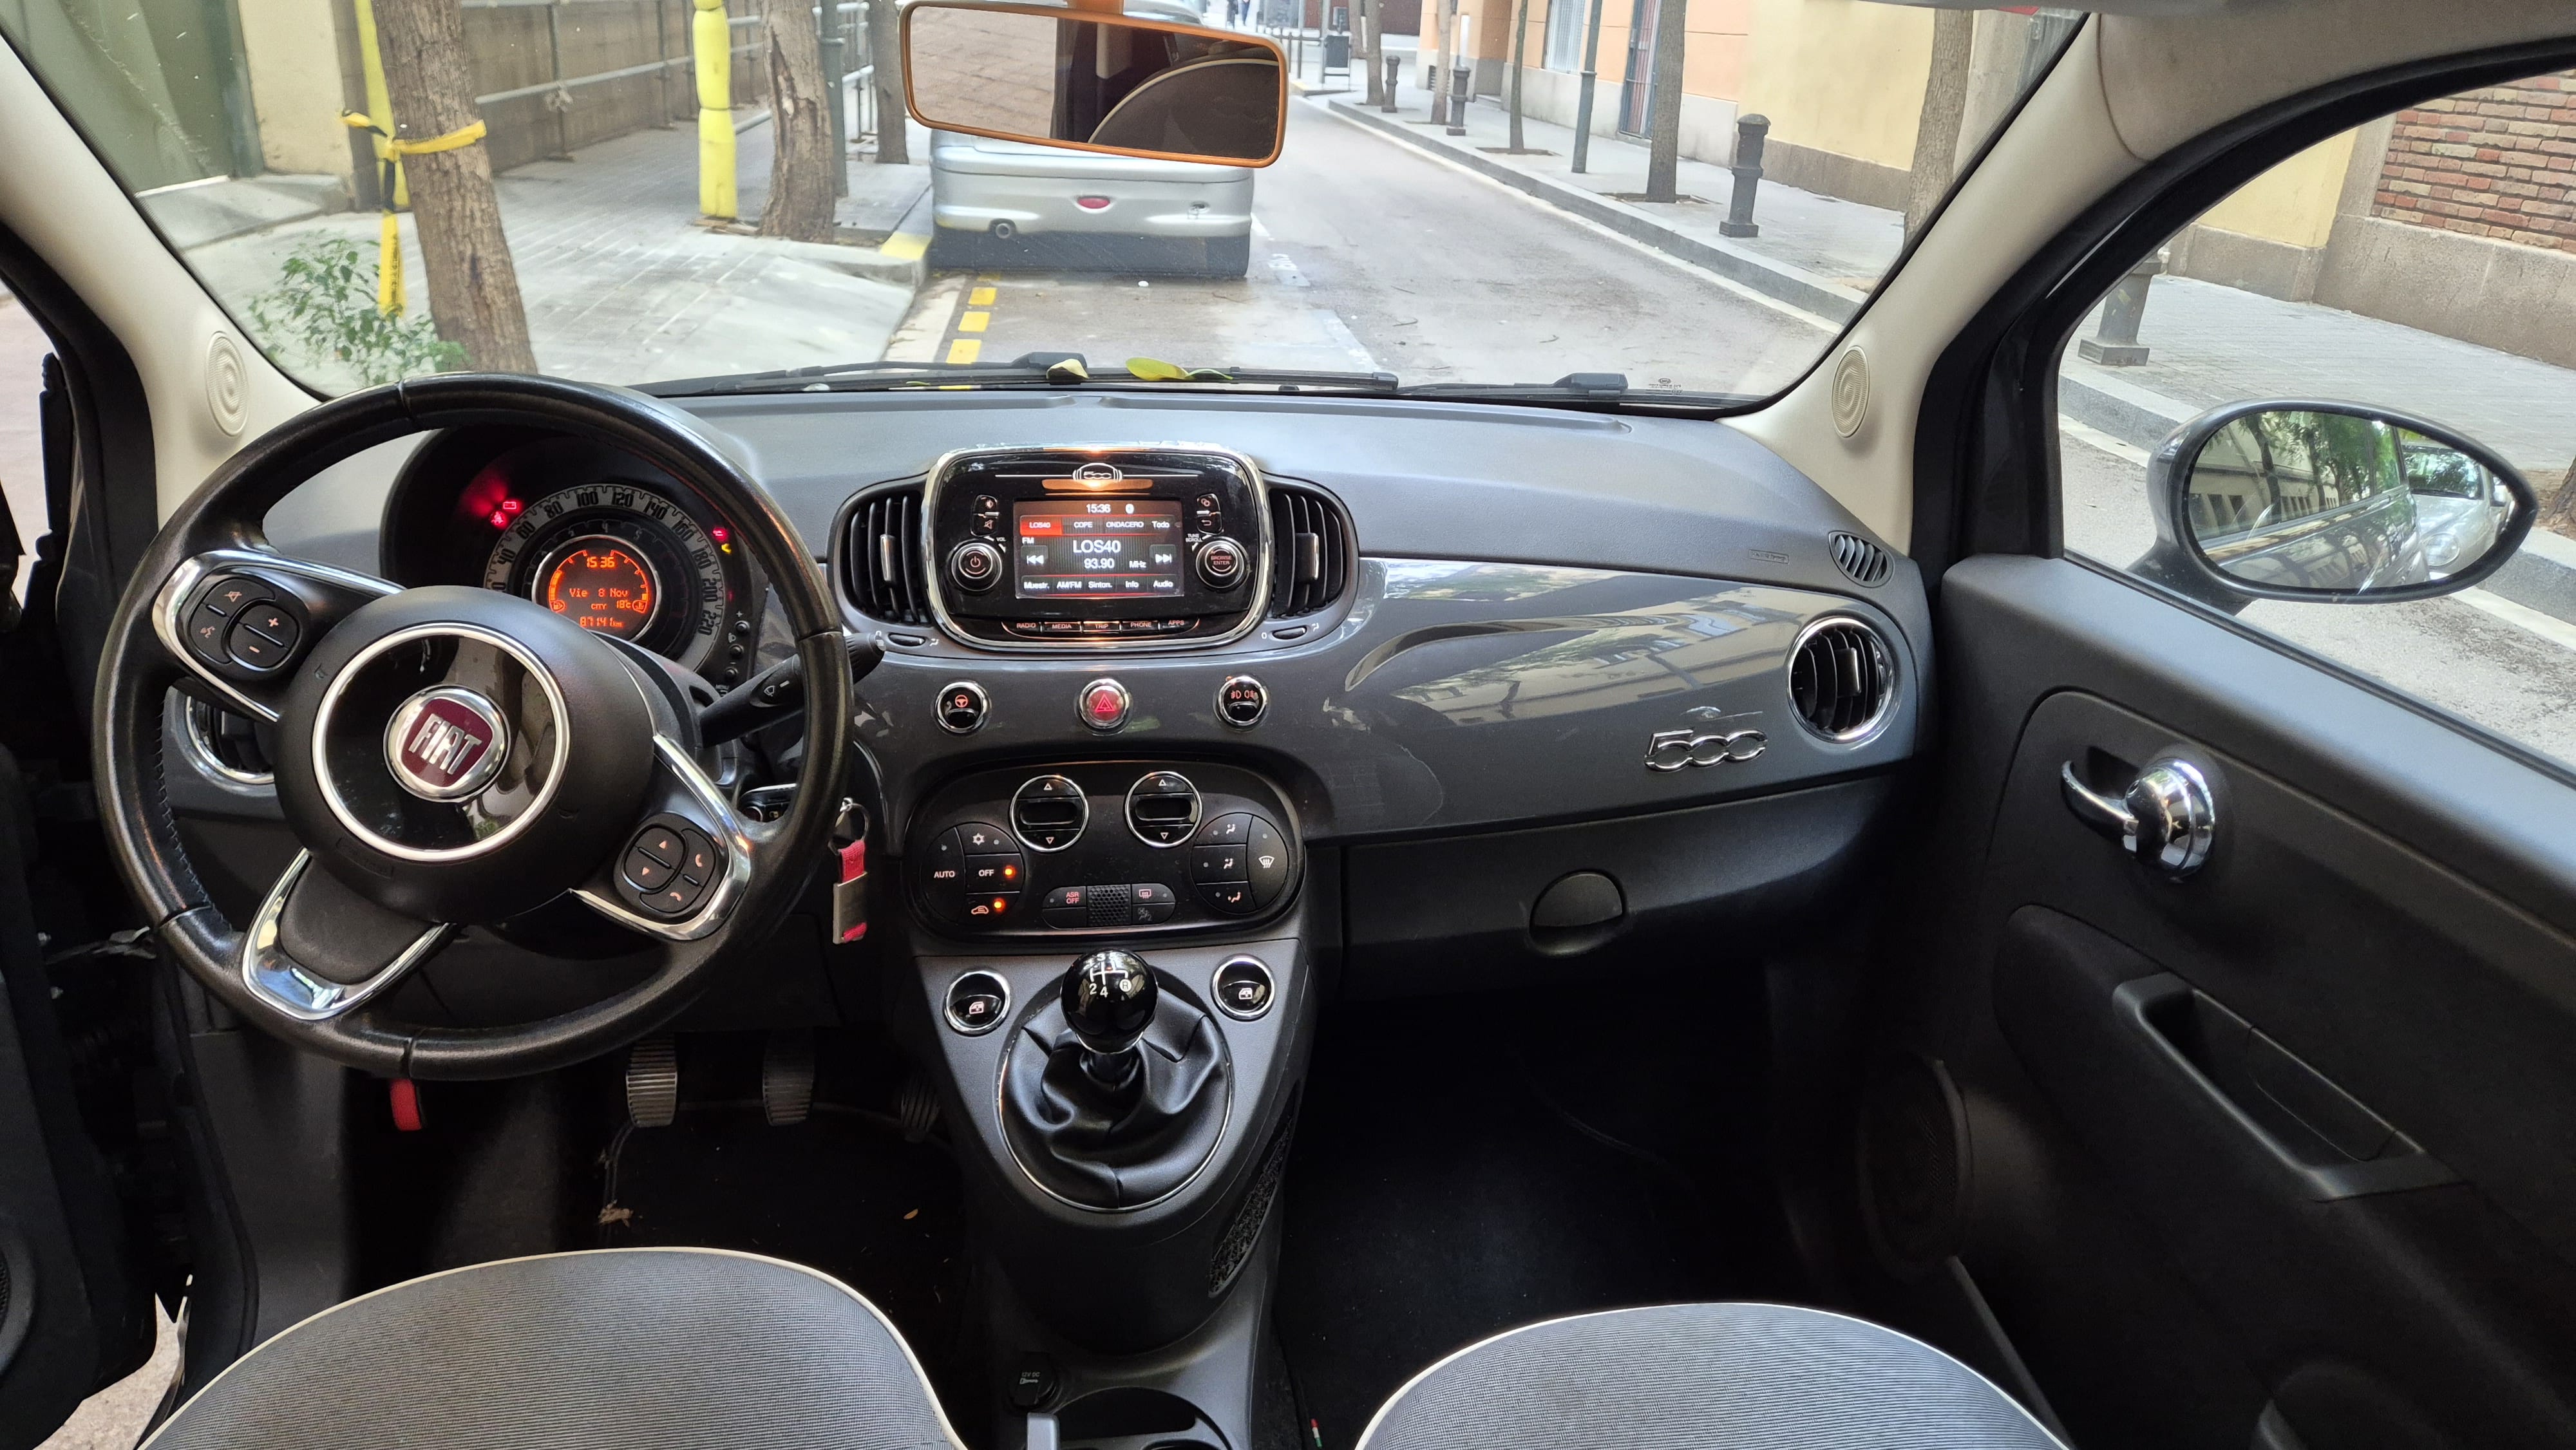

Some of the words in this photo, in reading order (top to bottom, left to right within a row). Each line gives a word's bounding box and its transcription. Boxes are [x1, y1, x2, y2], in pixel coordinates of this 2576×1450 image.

[577, 491, 599, 505] 100
[612, 492, 634, 507] 120
[545, 500, 564, 518] 80
[644, 498, 668, 520] 140
[1086, 504, 1112, 514] 15:36
[516, 520, 536, 540] 60
[673, 517, 696, 542] 160
[1151, 520, 1170, 529] Todo
[1072, 540, 1121, 554] LOS40
[497, 548, 516, 564] 40
[692, 545, 712, 570] 180
[1084, 558, 1115, 569] 93.90
[702, 578, 718, 603] 200
[1153, 580, 1173, 588] Audio
[569, 588, 588, 598] Vie
[598, 588, 605, 598] 8
[609, 588, 629, 598] Nov
[698, 611, 717, 636] 220
[408, 713, 482, 775] FIAT
[1644, 727, 1768, 773] 500
[1097, 953, 1106, 961] 3
[1089, 983, 1097, 995] 2
[1099, 986, 1108, 998] 4
